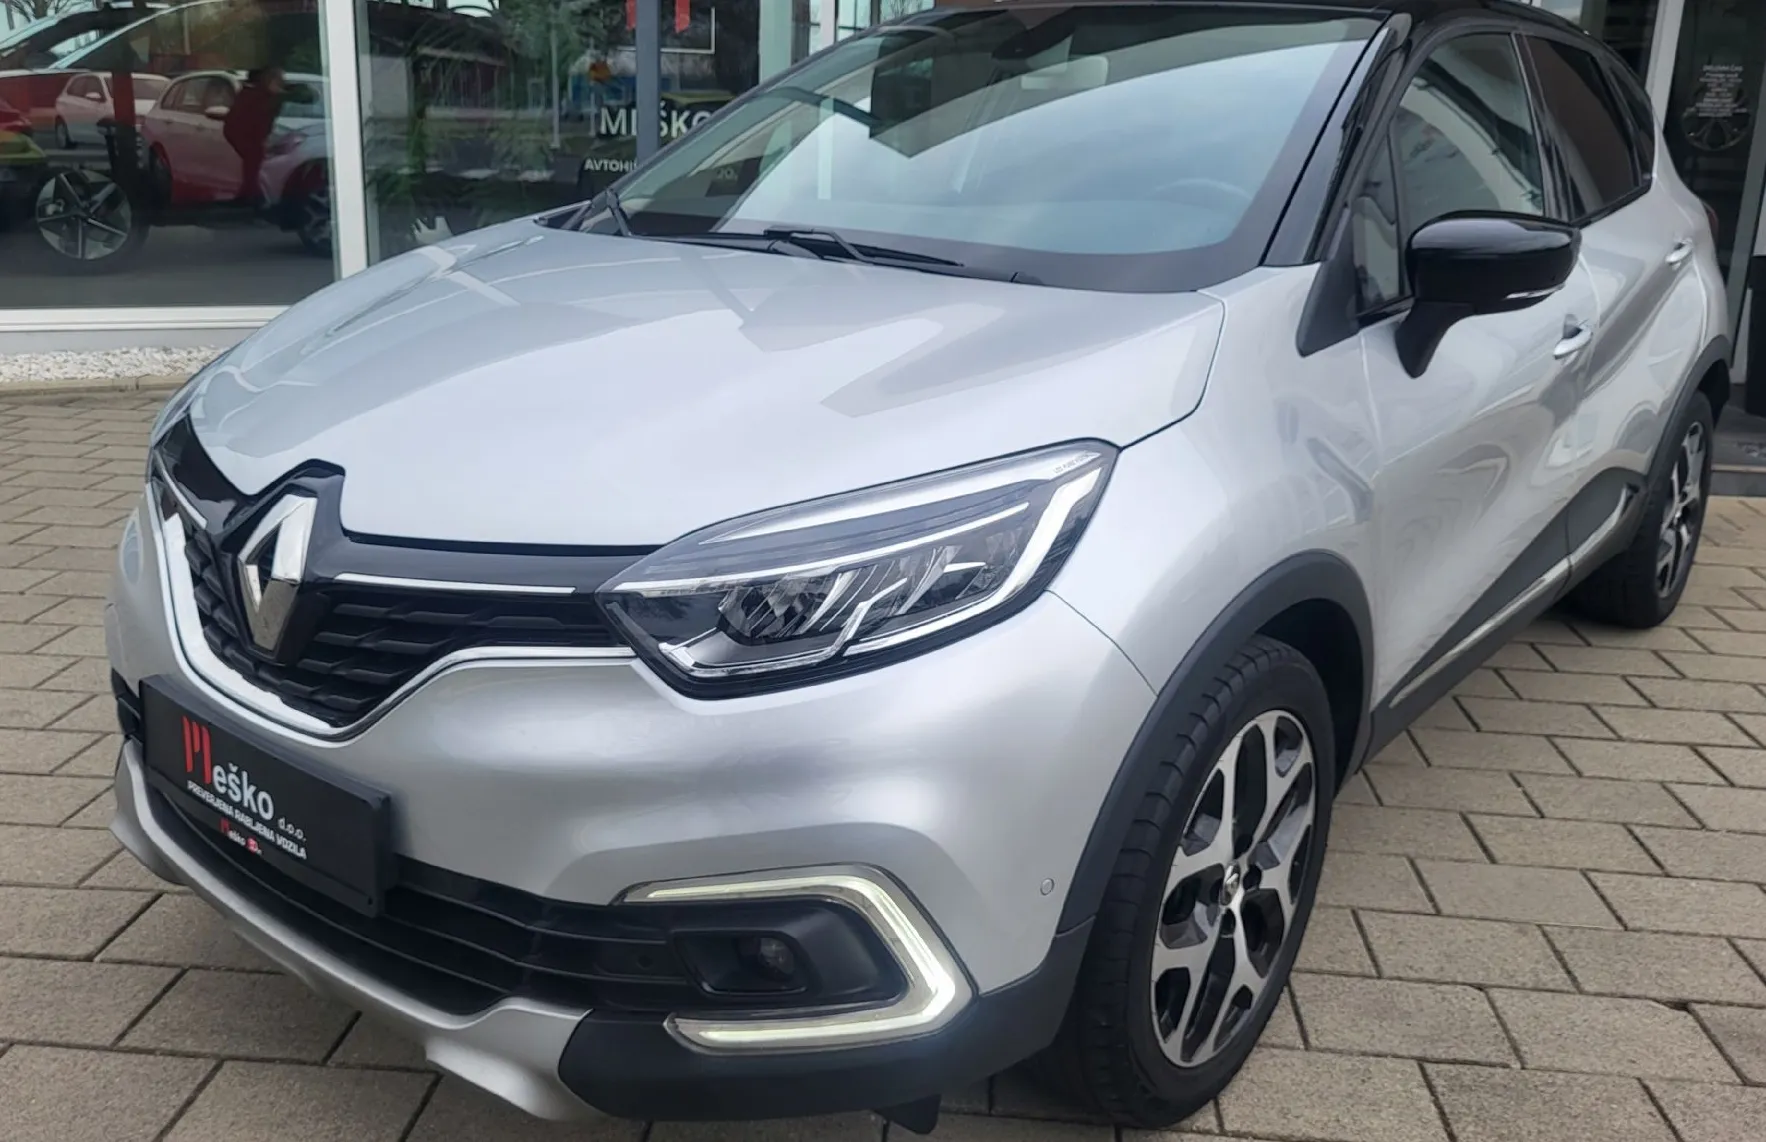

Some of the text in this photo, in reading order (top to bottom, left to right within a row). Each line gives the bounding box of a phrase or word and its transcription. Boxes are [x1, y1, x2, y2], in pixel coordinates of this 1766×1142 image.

[183, 715, 307, 842] Meško d.o.o.
[275, 833, 307, 860] VOZILA
